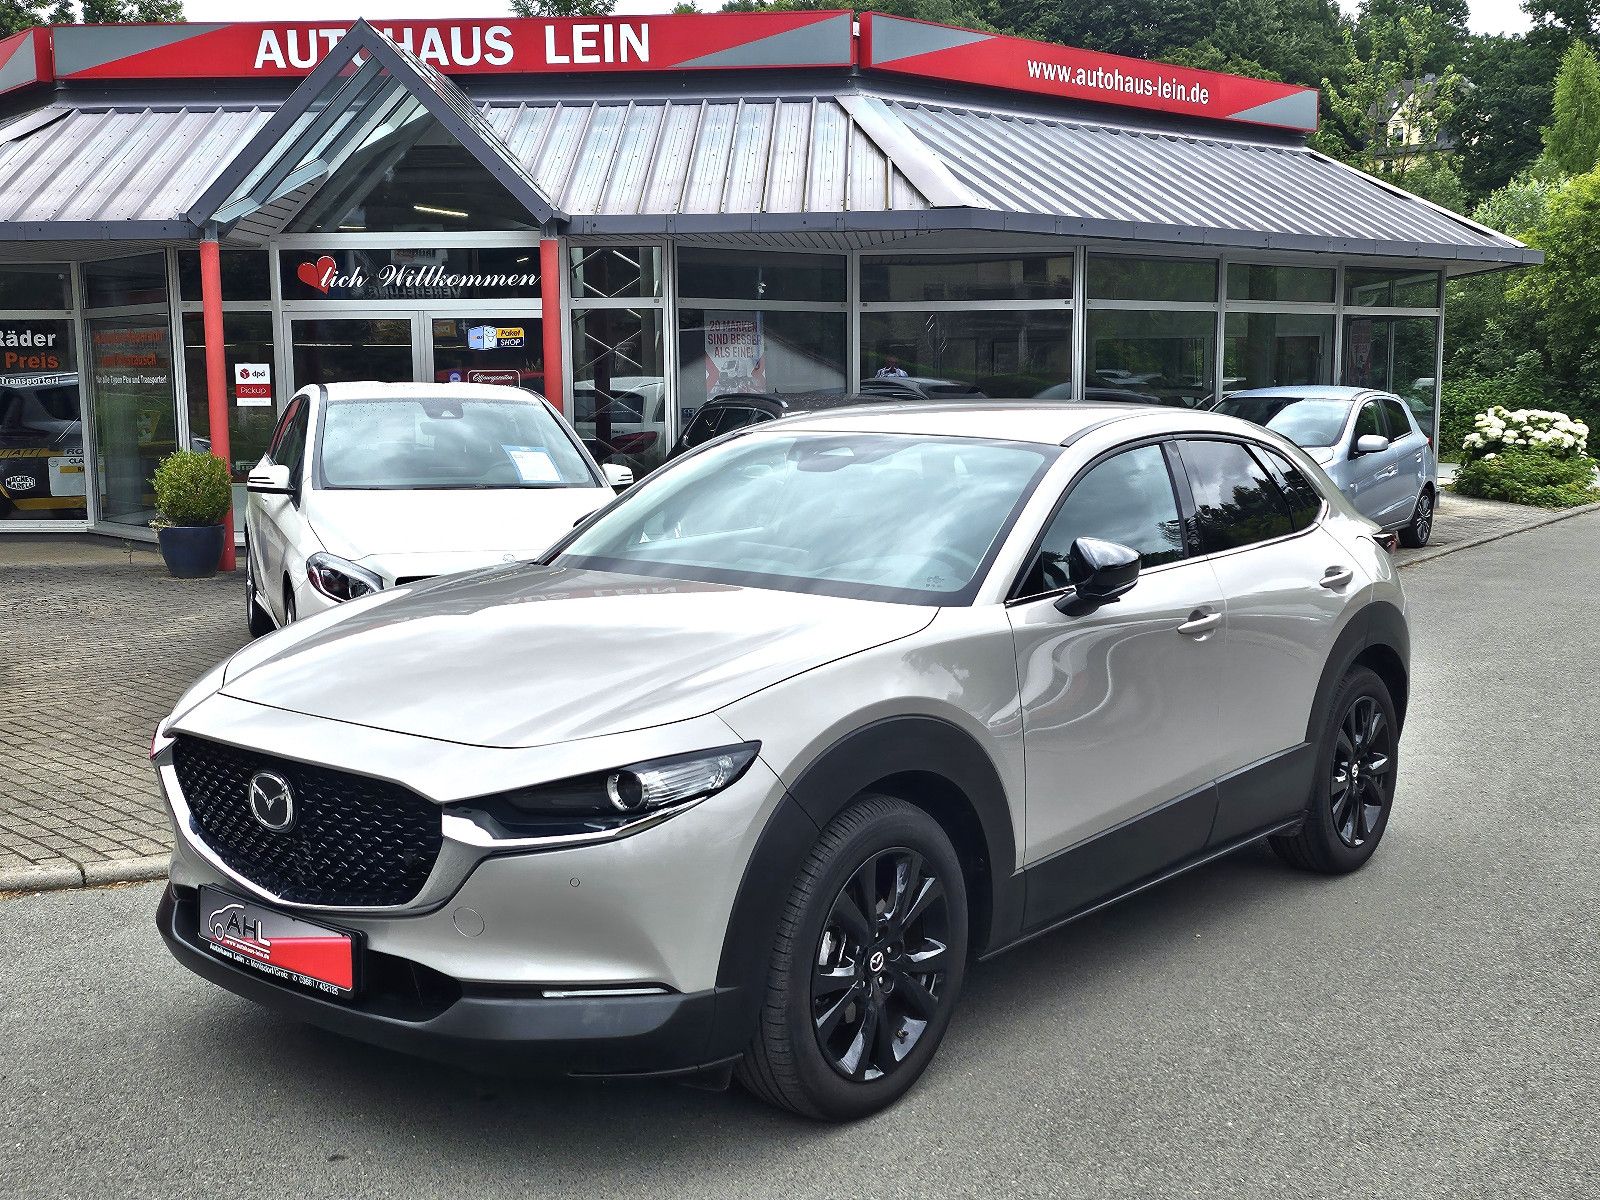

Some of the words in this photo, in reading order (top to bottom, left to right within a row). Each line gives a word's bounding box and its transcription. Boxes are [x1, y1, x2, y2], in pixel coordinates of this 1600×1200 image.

[254, 26, 514, 69] AUTHAUS
[545, 23, 650, 65] LEIN
[1027, 59, 1210, 105] www.autohaus-lein.de
[378, 264, 541, 288] Willkommen
[501, 329, 521, 337] Paket
[707, 333, 728, 345] SIND
[500, 338, 521, 346] SHOP
[714, 346, 730, 358] ALS
[5, 351, 58, 369] Preis
[251, 369, 266, 379] dpd
[0, 376, 59, 386] Transporter!
[240, 386, 267, 395] Pickup
[226, 910, 271, 947] AHL
[209, 942, 233, 959] Autohaus
[233, 952, 245, 964] Lein
